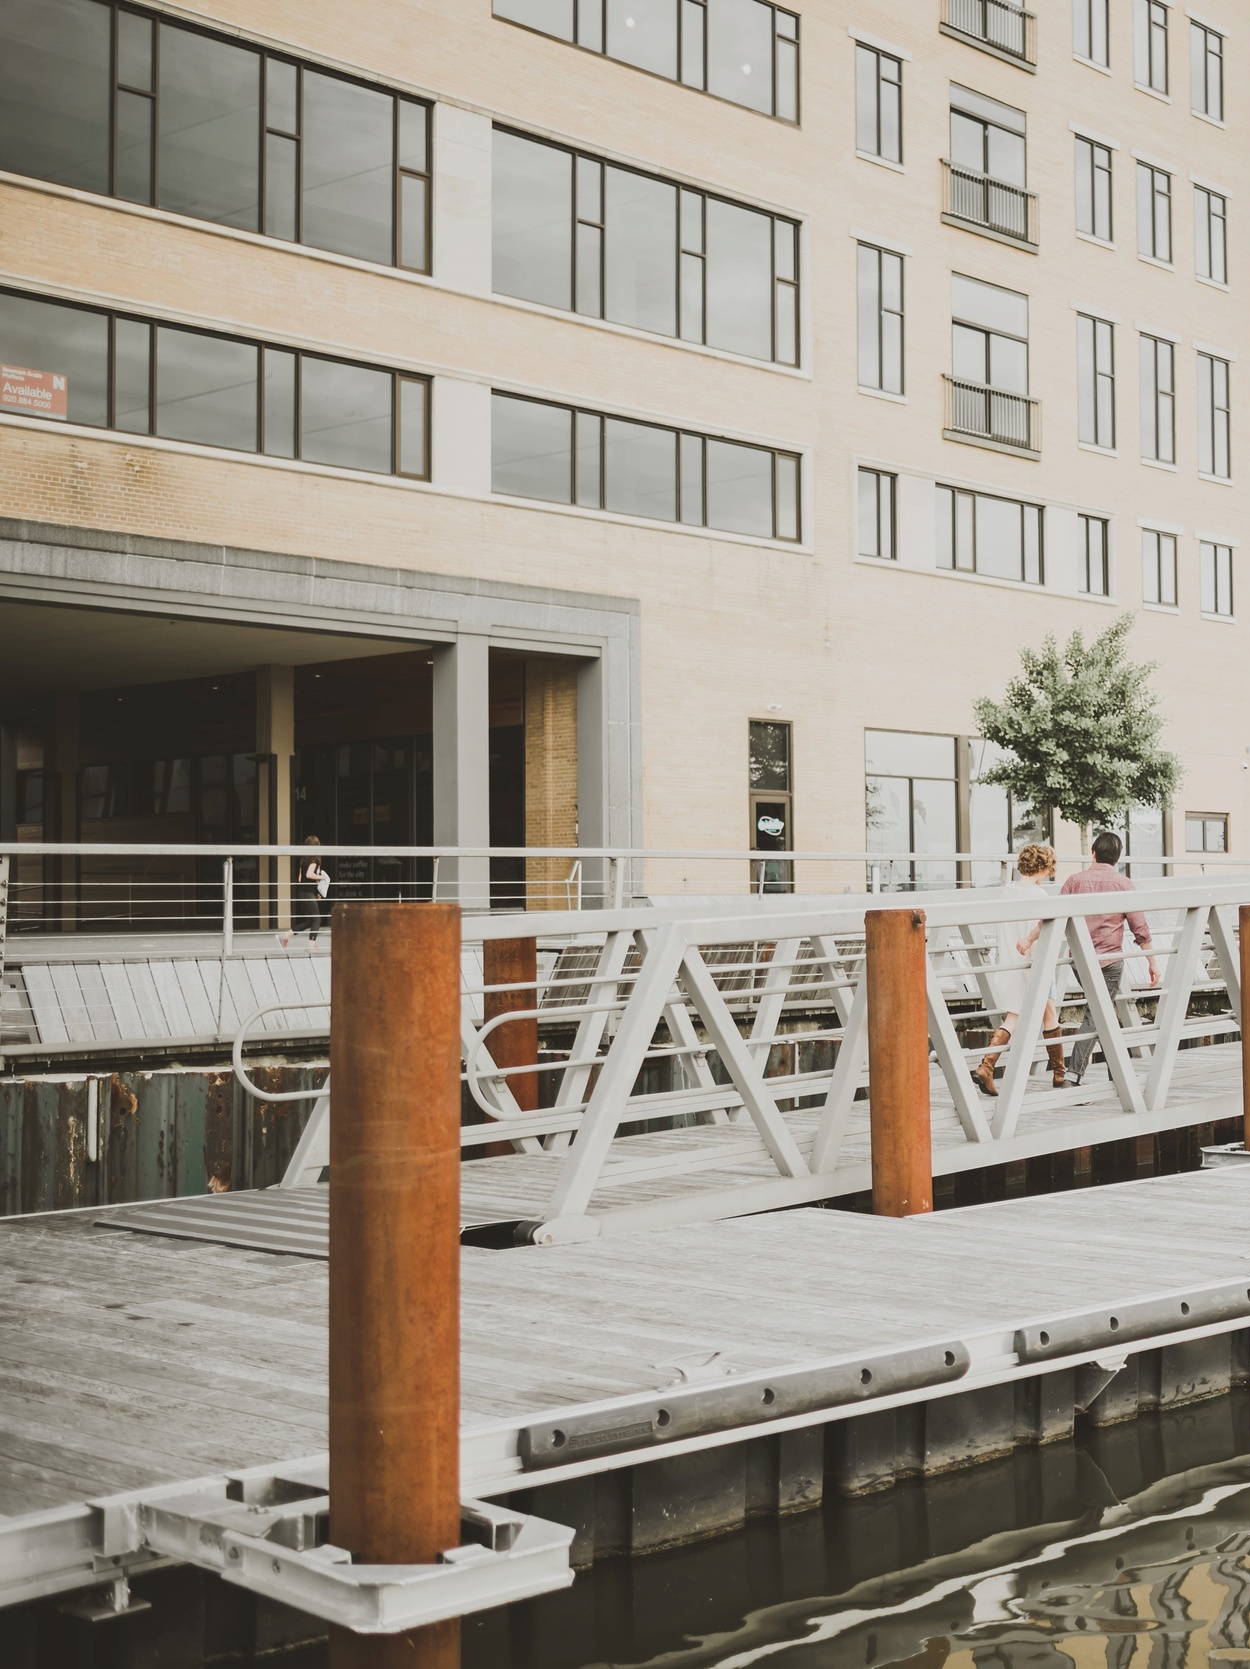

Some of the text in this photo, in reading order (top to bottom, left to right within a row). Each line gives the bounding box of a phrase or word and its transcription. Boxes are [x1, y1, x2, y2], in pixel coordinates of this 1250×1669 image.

[52, 375, 65, 390] N
[3, 382, 53, 400] Available
[3, 394, 52, 409] 920.884.5000
[295, 786, 306, 801] 14
